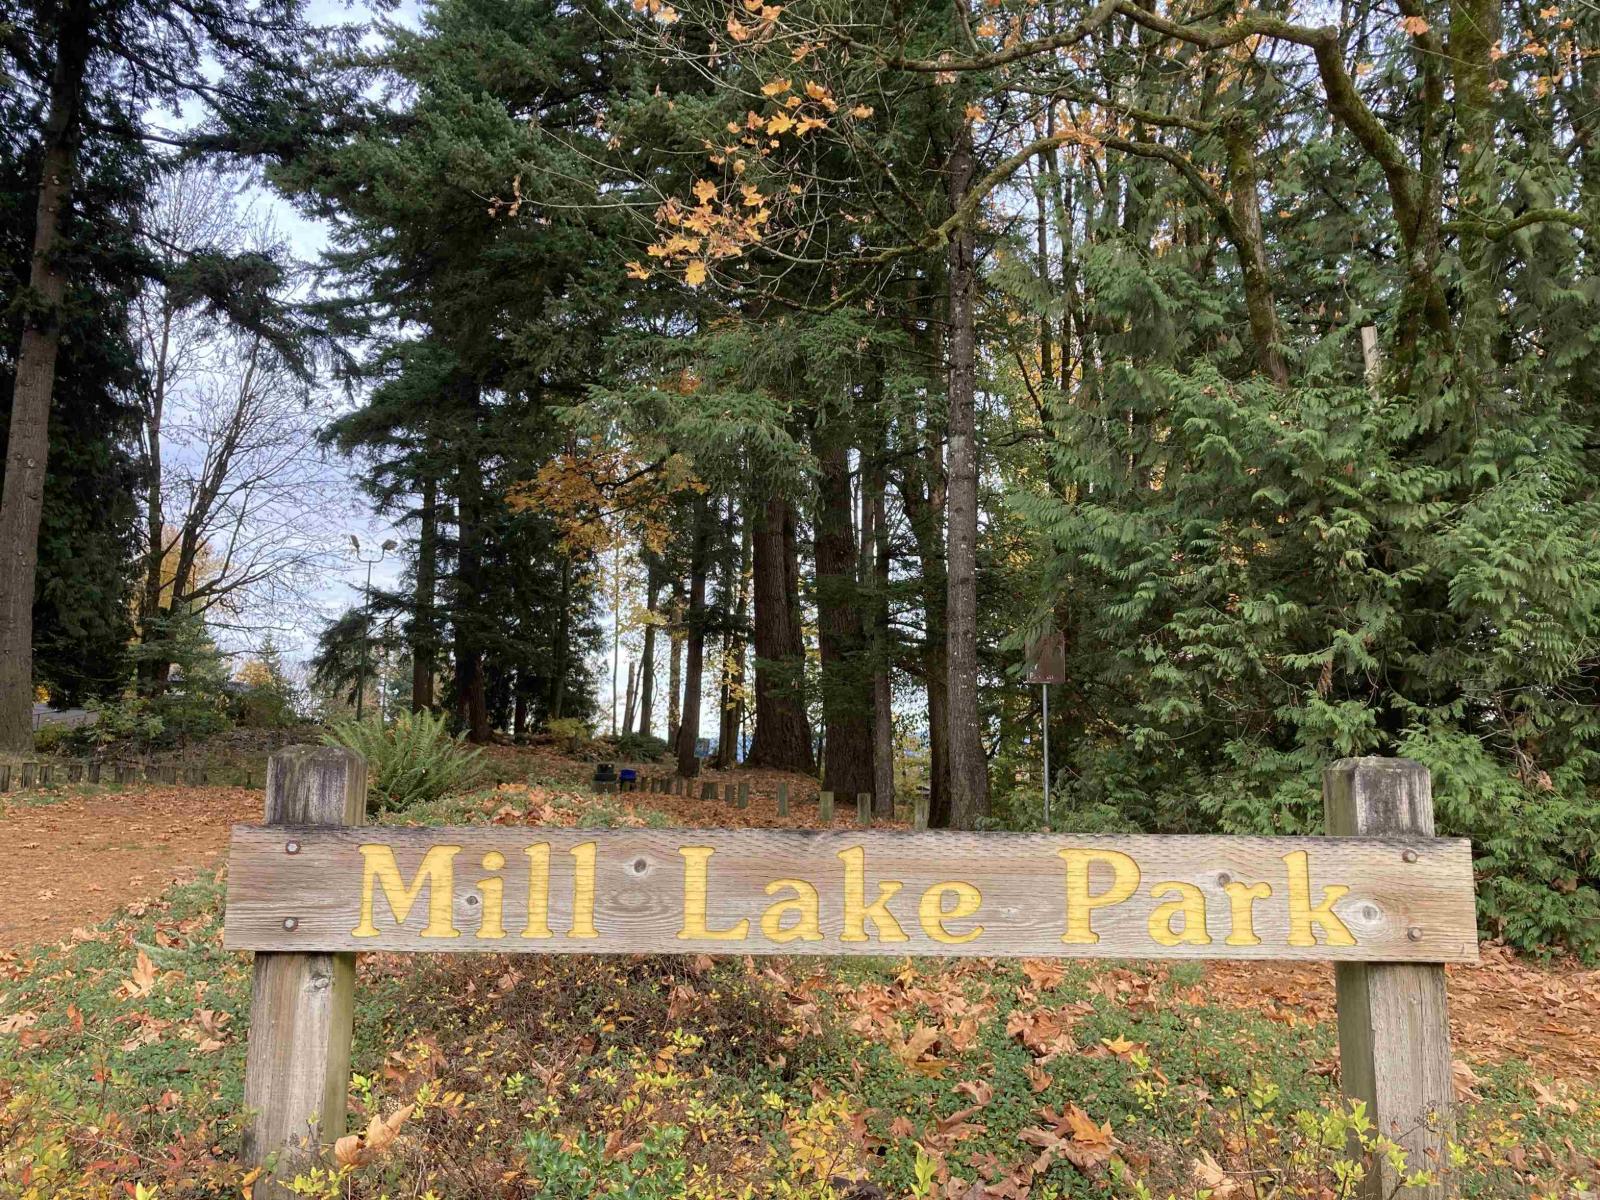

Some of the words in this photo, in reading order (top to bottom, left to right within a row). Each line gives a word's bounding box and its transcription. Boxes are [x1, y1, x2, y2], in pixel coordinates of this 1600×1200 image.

[351, 842, 600, 940] Mill
[676, 845, 985, 943] Lake
[1057, 848, 1359, 947] Park
